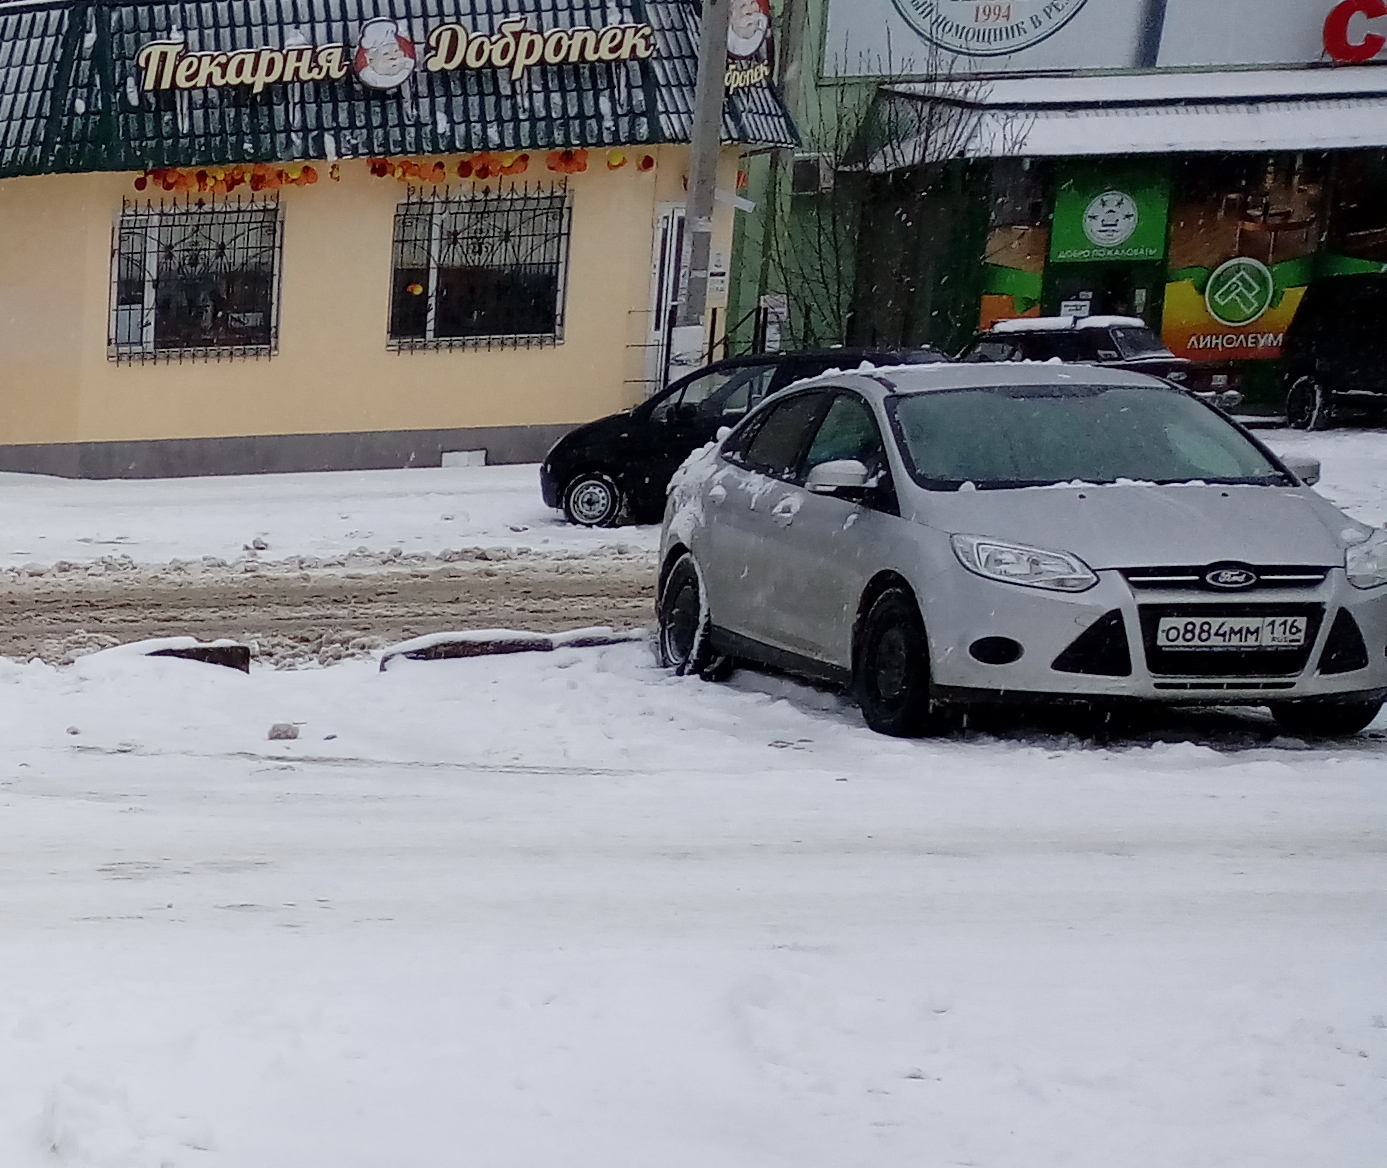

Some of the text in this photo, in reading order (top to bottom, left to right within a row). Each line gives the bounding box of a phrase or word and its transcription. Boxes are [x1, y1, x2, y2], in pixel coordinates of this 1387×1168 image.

[974, 4, 1012, 23] 1994
[1030, 14, 1042, 30] В
[138, 15, 656, 94] Пекарня Добропек
[1186, 332, 1284, 351] ЛИНОЛЕУМ
[1218, 571, 1246, 583] Ford
[1265, 619, 1300, 637] 116
